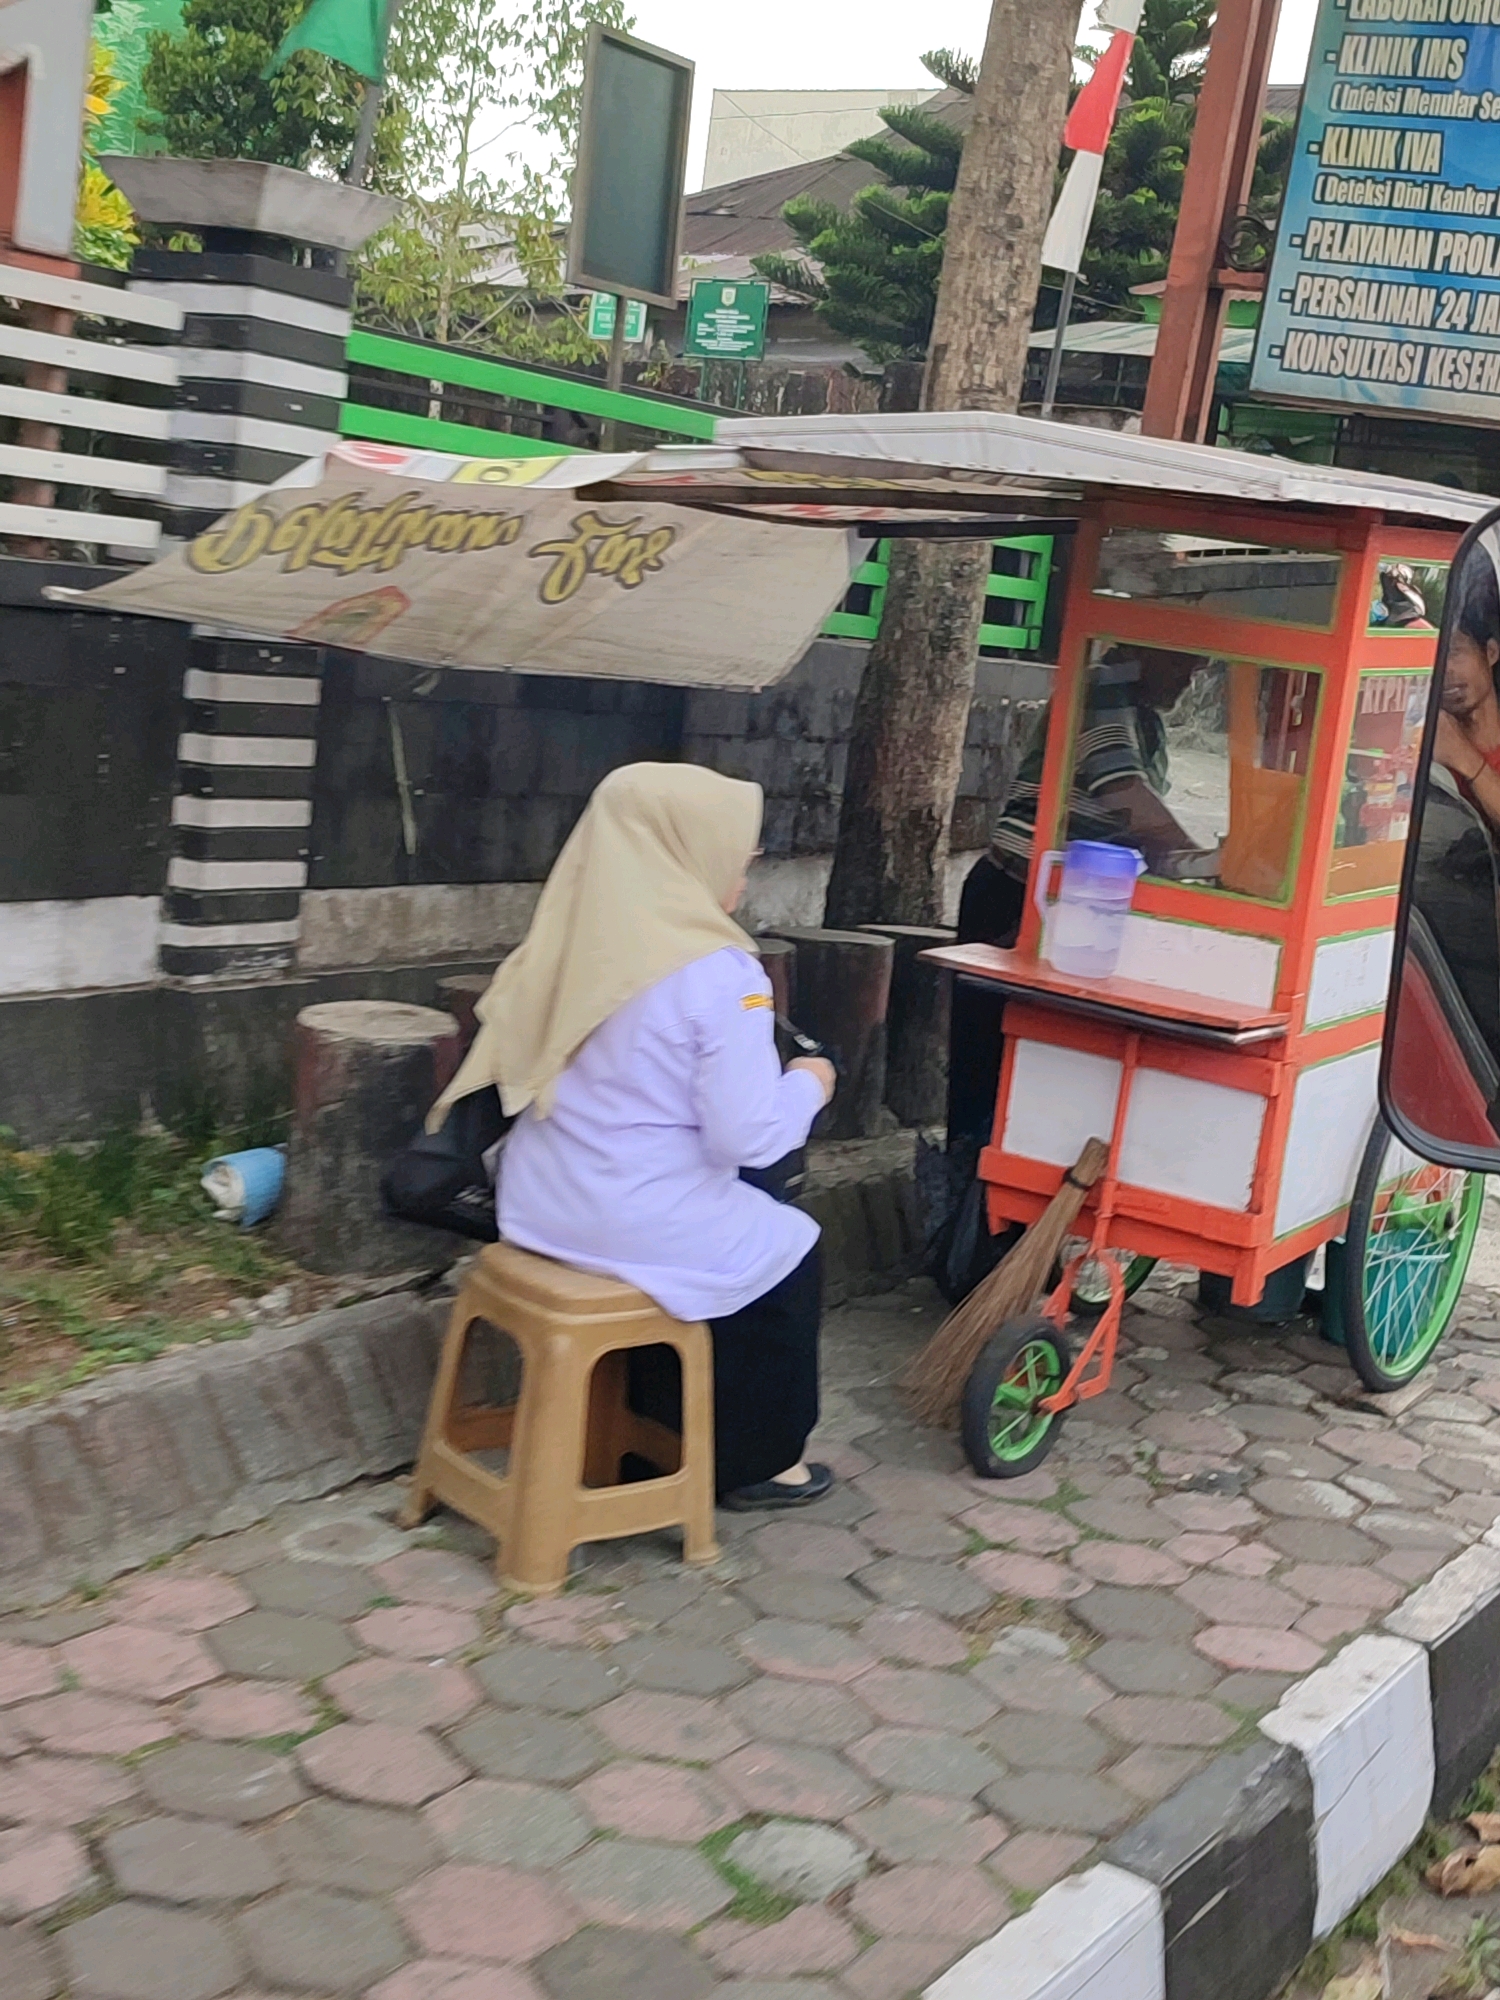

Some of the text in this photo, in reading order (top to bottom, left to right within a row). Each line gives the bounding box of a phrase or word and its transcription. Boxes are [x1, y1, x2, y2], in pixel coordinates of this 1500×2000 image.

[1417, 38, 1466, 80] IMS
[1402, 87, 1478, 118] Menular
[1400, 131, 1442, 173] IVA
[1392, 181, 1429, 210] Dini
[1429, 184, 1496, 216] Kanker
[1433, 232, 1500, 277] PROL
[1435, 289, 1472, 331] 24
[1469, 293, 1500, 334] JA
[1423, 347, 1500, 394] KESEH
